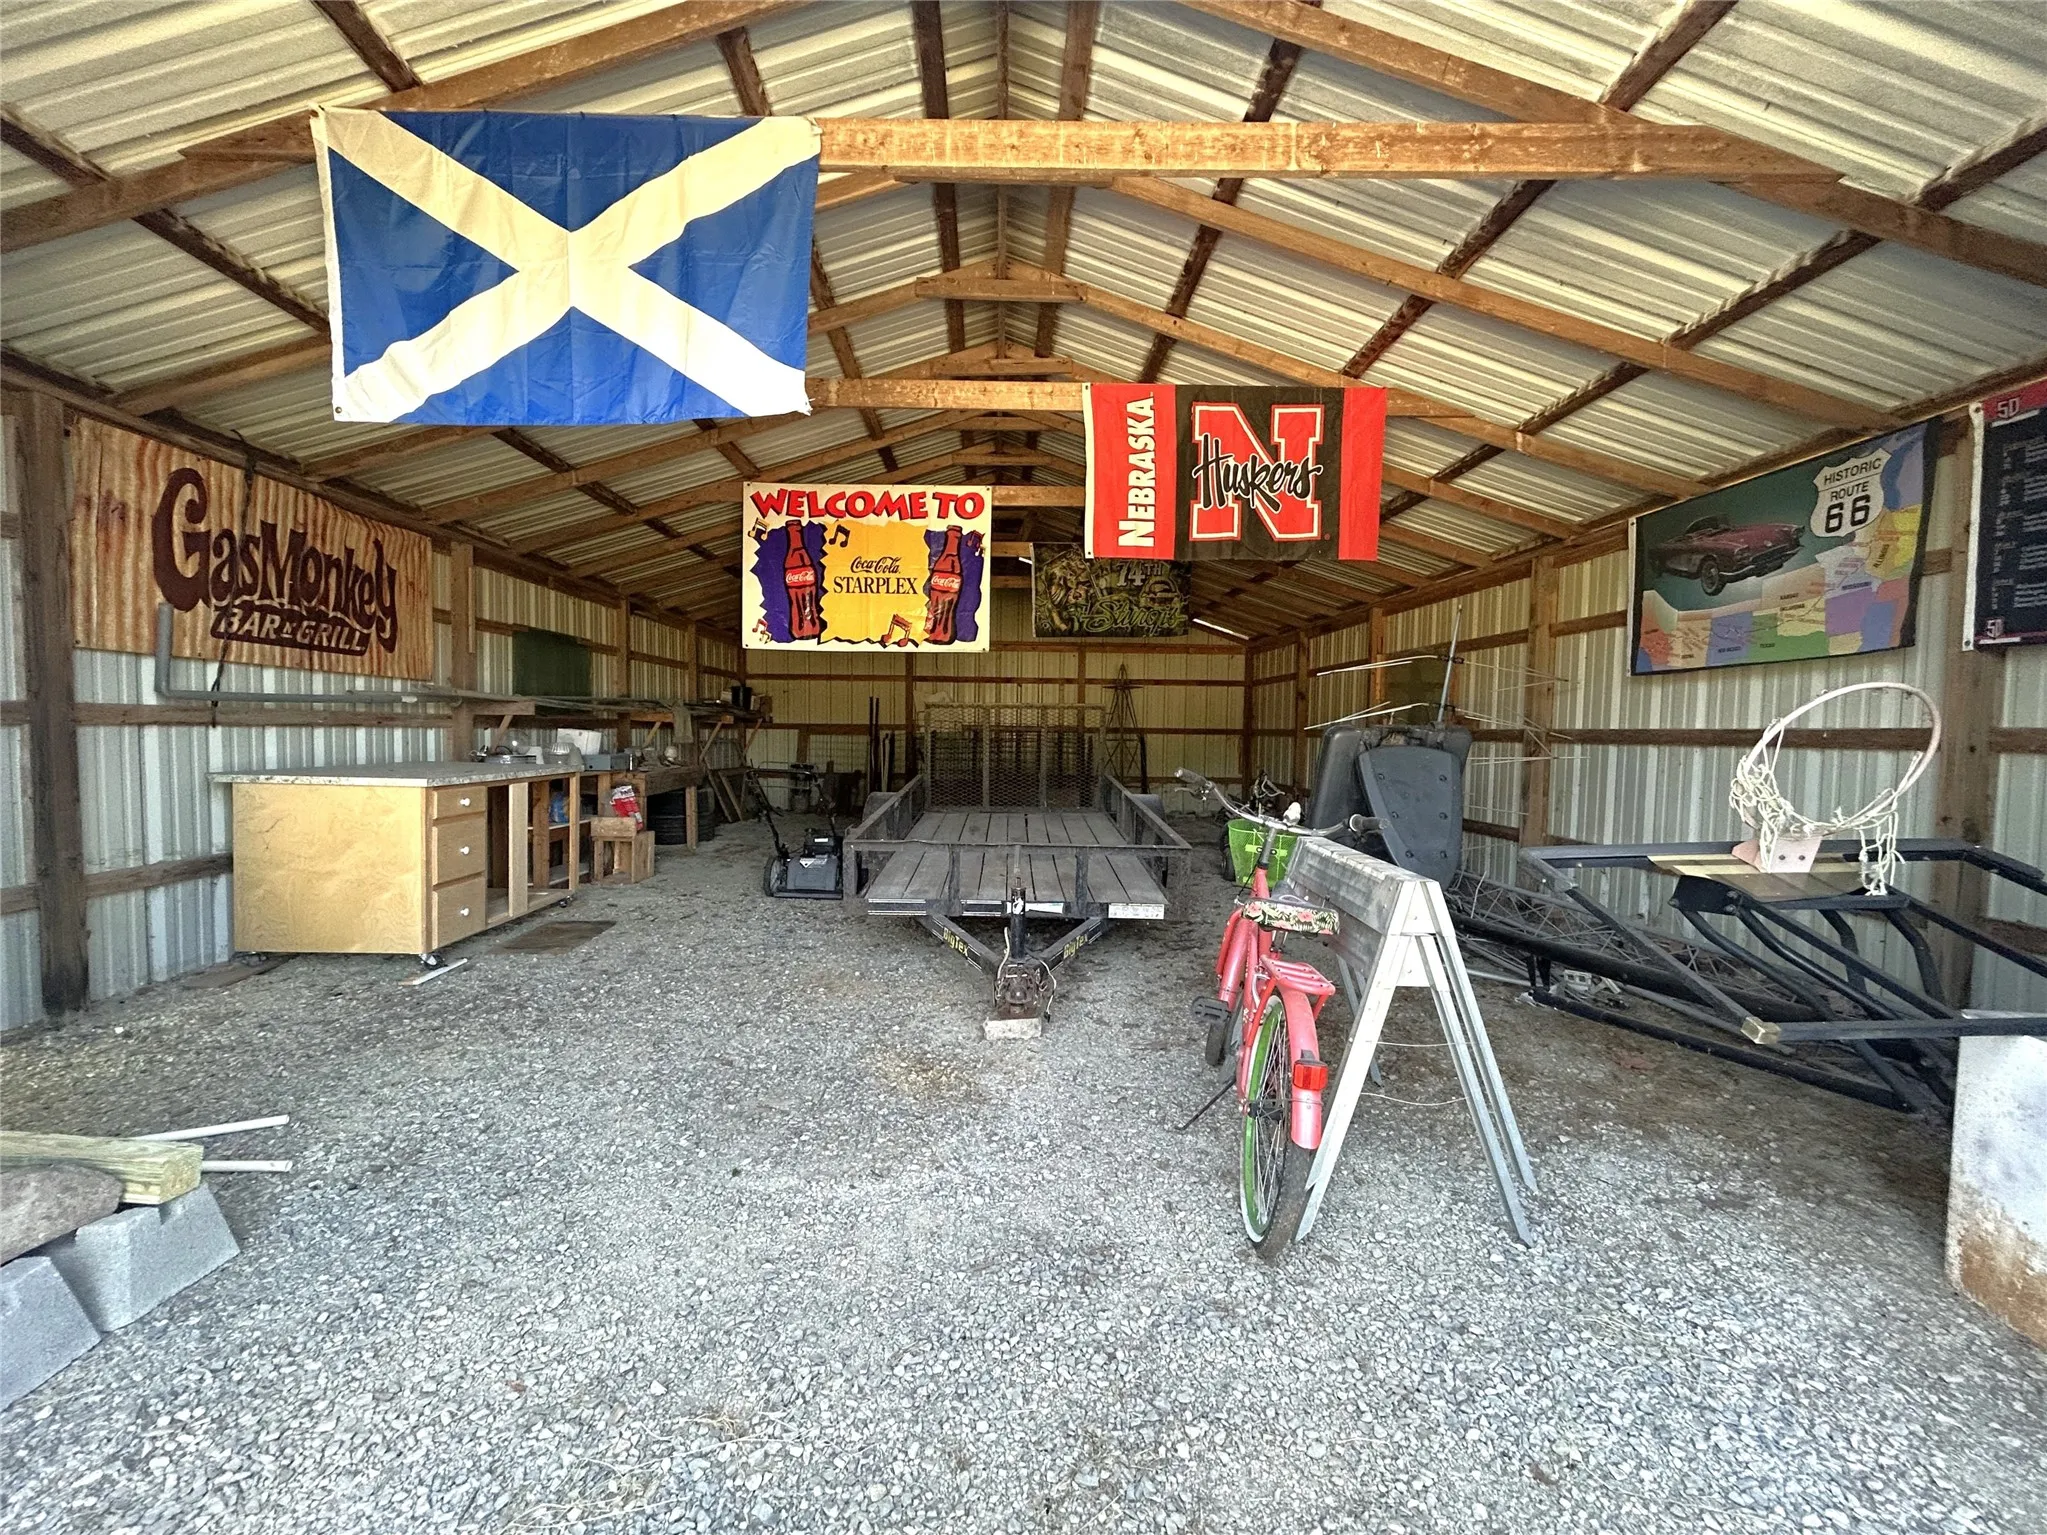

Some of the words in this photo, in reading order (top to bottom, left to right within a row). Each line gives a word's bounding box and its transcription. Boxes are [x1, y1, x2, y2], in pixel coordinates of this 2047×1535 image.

[1118, 397, 1155, 547] NEBRASKA
[1188, 401, 1325, 541] N
[1192, 432, 1324, 514] Huskers
[1824, 458, 1882, 485] HISTORIC
[750, 488, 928, 520] WELCOME
[932, 491, 985, 519] TO
[1830, 481, 1869, 502] ROUTE
[1824, 494, 1871, 533] 66
[850, 555, 902, 574] Coca-Cola
[833, 576, 918, 595] STARPLEX
[215, 607, 281, 639] BAR
[296, 620, 368, 651] GRILL
